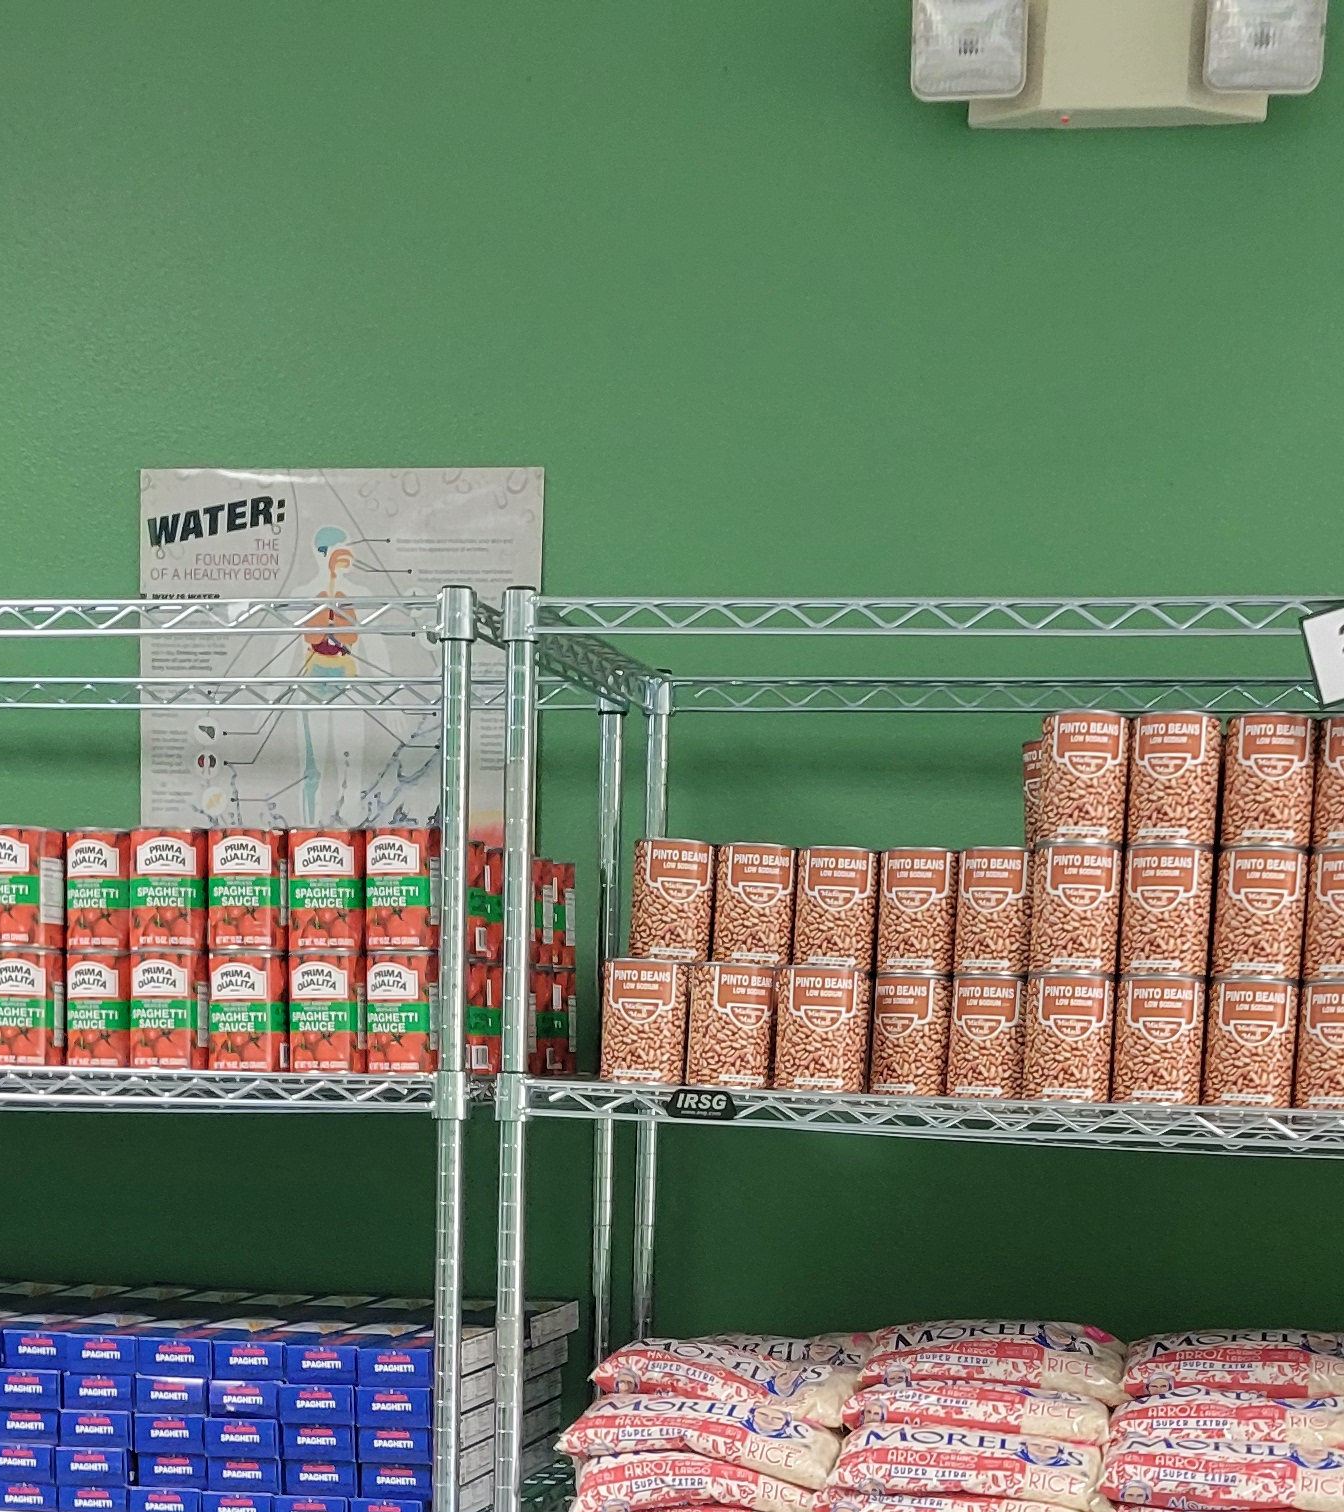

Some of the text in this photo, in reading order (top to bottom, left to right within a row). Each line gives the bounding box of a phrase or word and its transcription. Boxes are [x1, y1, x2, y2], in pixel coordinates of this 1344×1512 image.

[147, 496, 286, 548] WATER:
[254, 538, 279, 551] THE
[196, 553, 279, 566] FOUNDATION
[150, 568, 280, 581] OF A HEALTHY BODY
[1059, 722, 1119, 736] PINTO BEANS
[1070, 735, 1084, 743] LOW
[149, 844, 182, 855] PRIMA
[224, 843, 256, 853] PRIMA
[306, 842, 340, 856] PRIMA
[653, 850, 708, 863] PINTO BEANS
[677, 862, 698, 870] SODIUM
[888, 858, 944, 870] PINTO BEANS
[911, 871, 932, 879] SODIUM
[137, 887, 196, 898] SPAGHETTI
[213, 886, 271, 897] SPAGHETTI
[295, 888, 355, 898] SPAGHETTI
[146, 897, 185, 907] SAUCE
[221, 896, 259, 906] SAUCE
[304, 898, 343, 908] SAUCE
[220, 969, 251, 981] PRIMA
[614, 969, 671, 983] PINTO BEANS
[637, 982, 659, 991] SODIUM
[795, 976, 853, 990] PINTO BEANS
[806, 989, 843, 998] LOW SODIUM
[1045, 985, 1103, 999] PINTO BEANS
[212, 1012, 267, 1023] SPAGHETTI
[219, 1022, 255, 1032] SAUCE
[676, 1092, 727, 1110] IRSG
[894, 1323, 1094, 1356] MORELS
[81, 1350, 120, 1360] SPAGHETTI
[229, 1356, 269, 1366] SPAGHETTI
[919, 1353, 989, 1365] SUPER EXTRA
[1175, 1349, 1225, 1361] ARROZ
[374, 1363, 415, 1373] SPAGHETTI
[1047, 1357, 1094, 1378] RICE
[1182, 1361, 1254, 1370] SUPER EXTRA
[4, 1384, 43, 1394] SPAGHETTI
[371, 1402, 412, 1412] SPAGHETTI
[595, 1400, 810, 1439] MORELS
[615, 1415, 663, 1426] ARROZ
[621, 1428, 690, 1438] SUPER EXTRA
[864, 1426, 1084, 1467] MORELS
[746, 1442, 795, 1468] RICE
[887, 1449, 938, 1463] ARROZ
[1155, 1455, 1207, 1471] ARROZ
[624, 1462, 672, 1477] ARROZ
[675, 1466, 711, 1475] LARGO
[893, 1466, 928, 1477] SUPER
[1162, 1469, 1237, 1484] SUPER EXTRA
[1027, 1472, 1080, 1496] RICE
[762, 1481, 808, 1508] RICE
